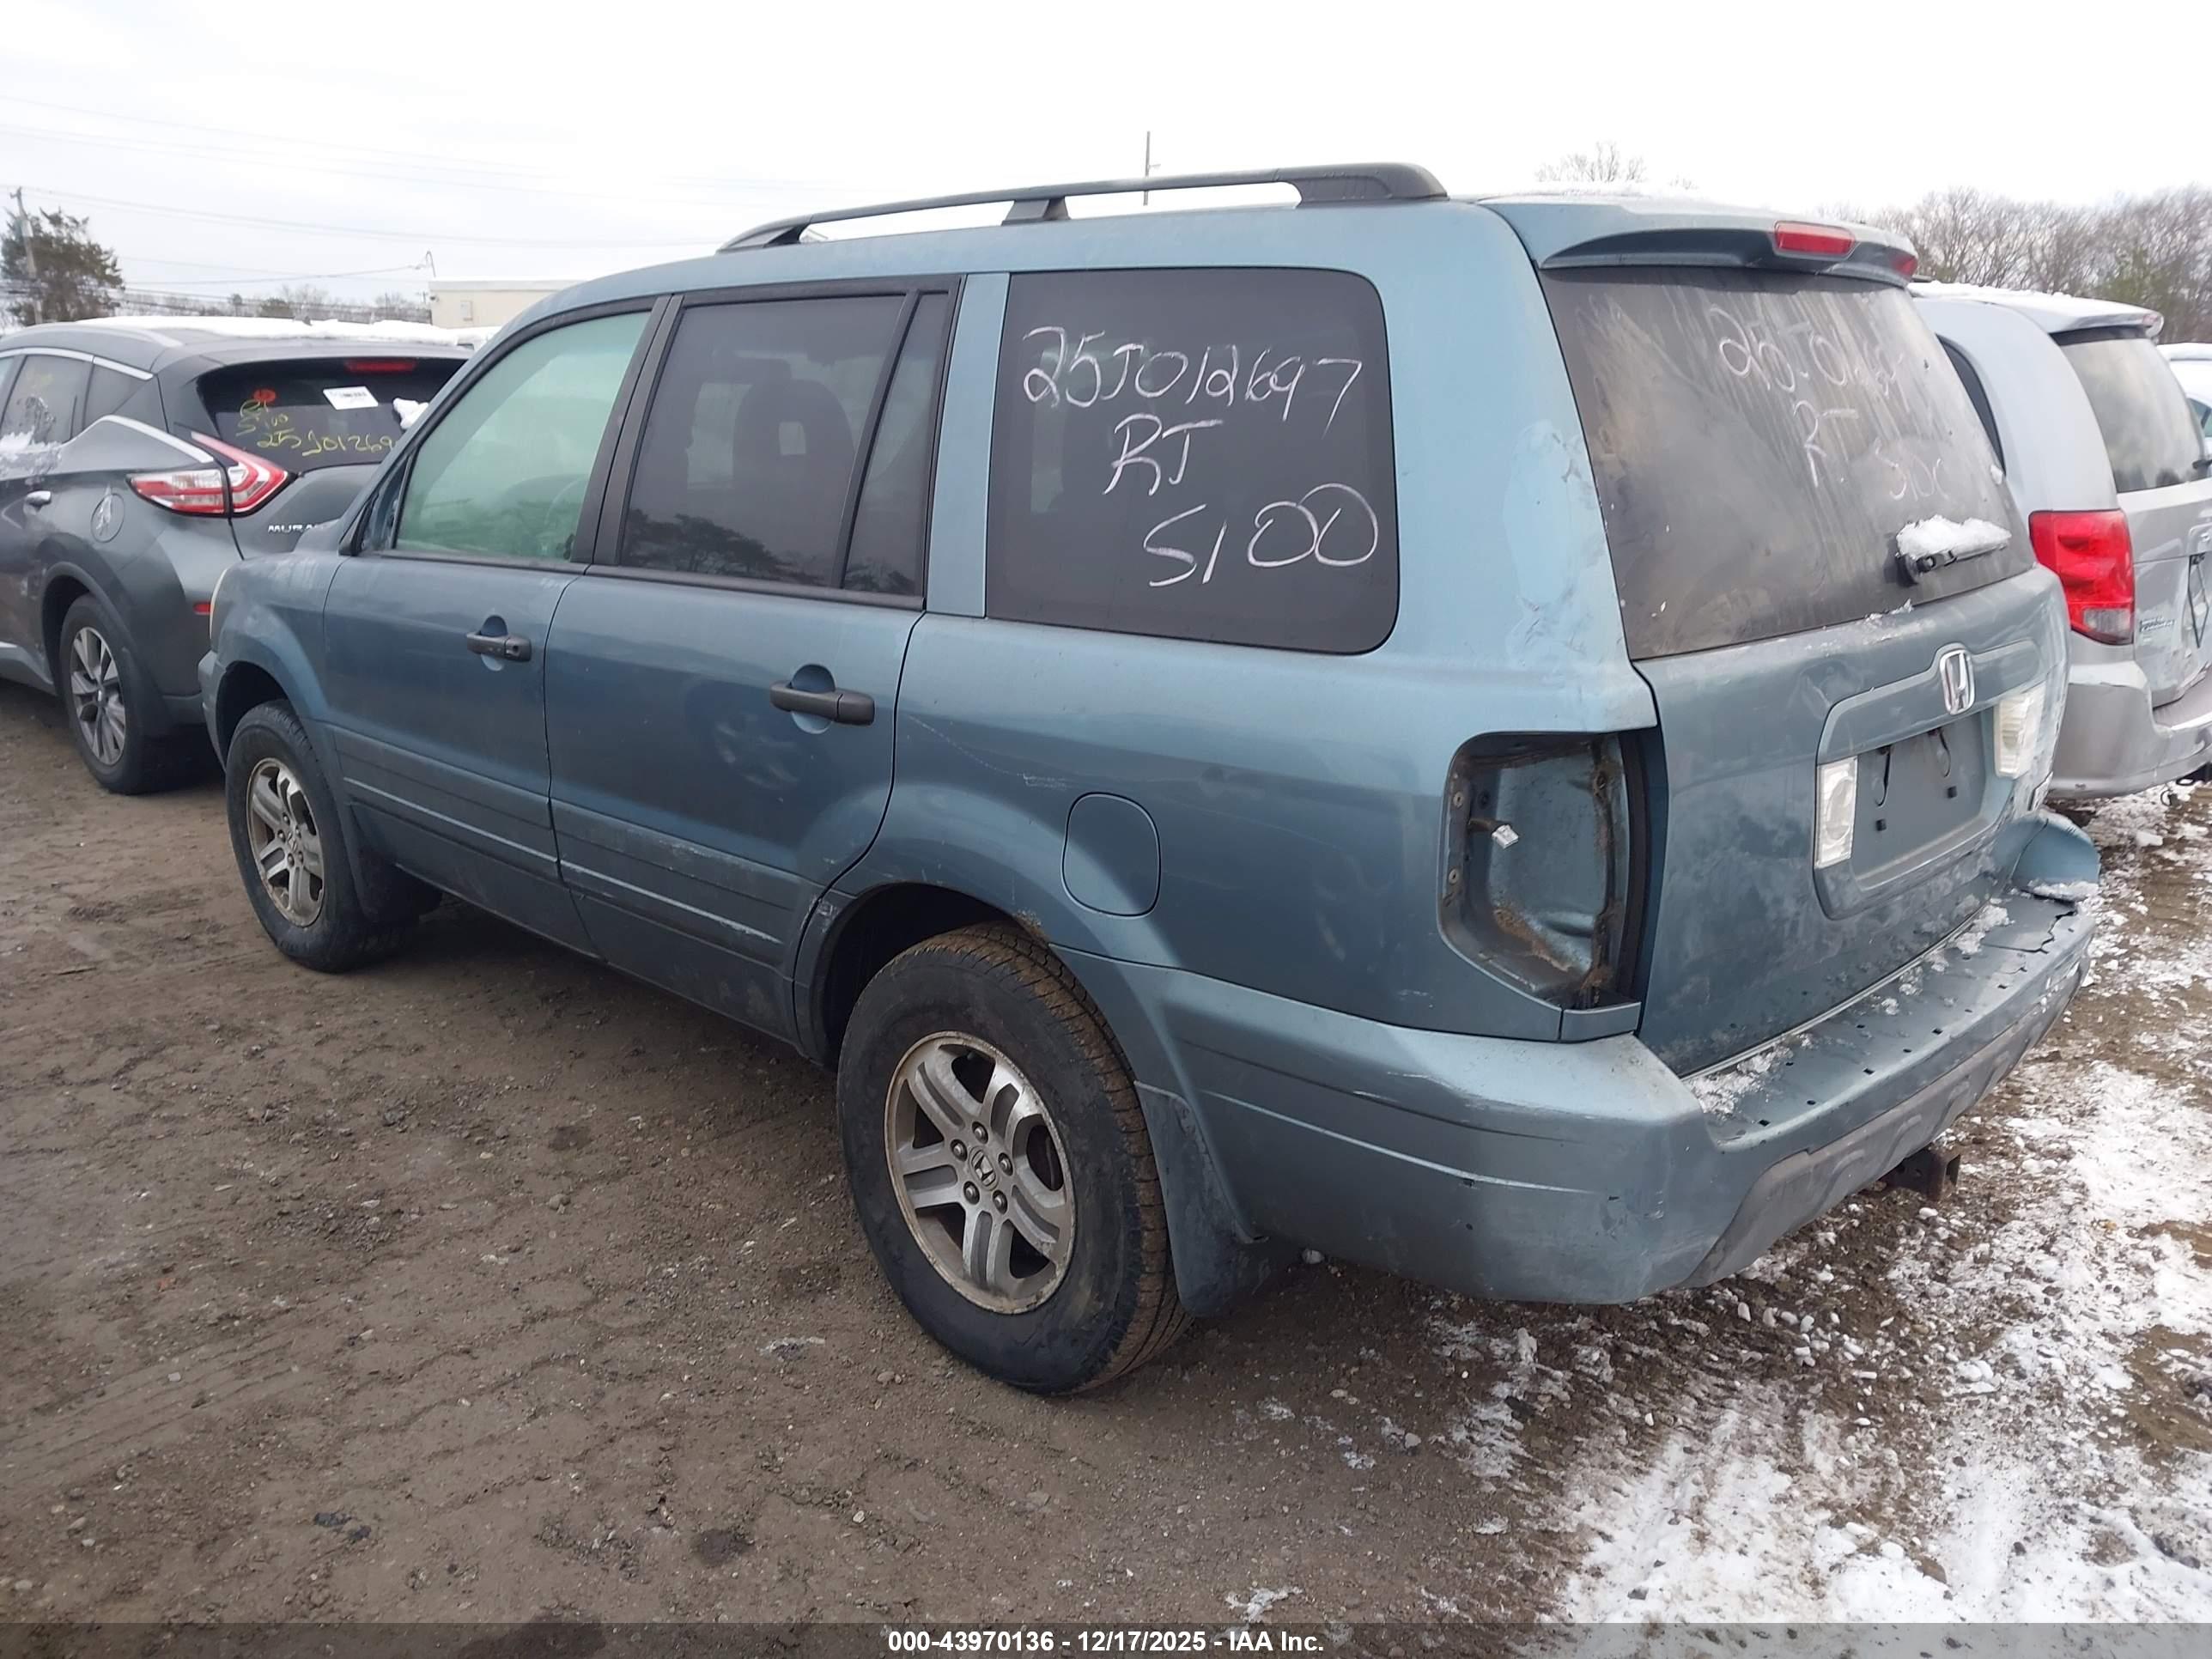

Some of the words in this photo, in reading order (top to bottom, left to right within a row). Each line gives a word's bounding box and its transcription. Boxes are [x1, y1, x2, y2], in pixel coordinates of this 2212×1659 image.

[1022, 325, 1363, 440] 25J012697
[1103, 413, 1224, 495] RT
[268, 523, 318, 534] MURA
[1143, 483, 1379, 587] S100
